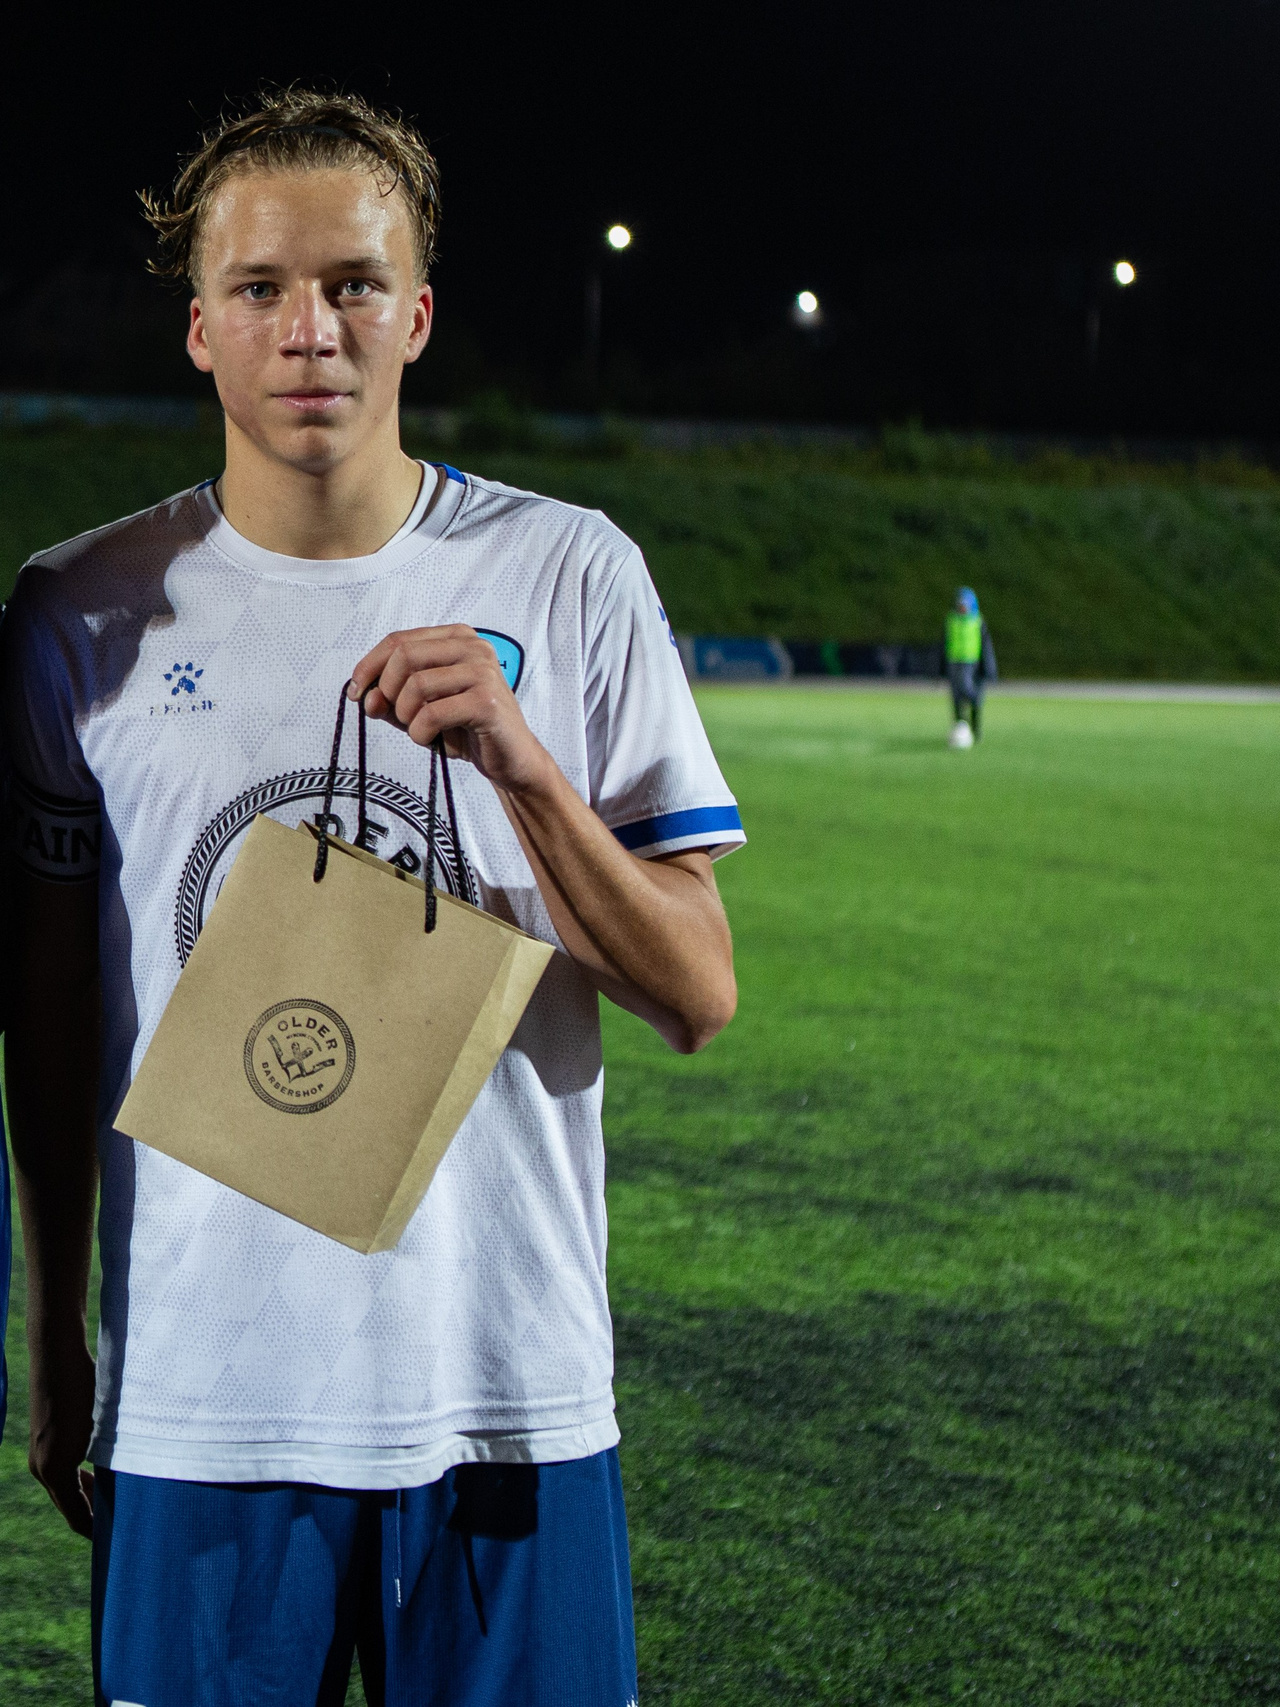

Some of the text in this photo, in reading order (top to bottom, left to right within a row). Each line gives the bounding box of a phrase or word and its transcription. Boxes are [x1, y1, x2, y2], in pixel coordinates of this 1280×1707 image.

[21, 815, 101, 863] AIN
[277, 1016, 338, 1050] OLDER
[261, 1061, 324, 1097] BARBERSHOP
